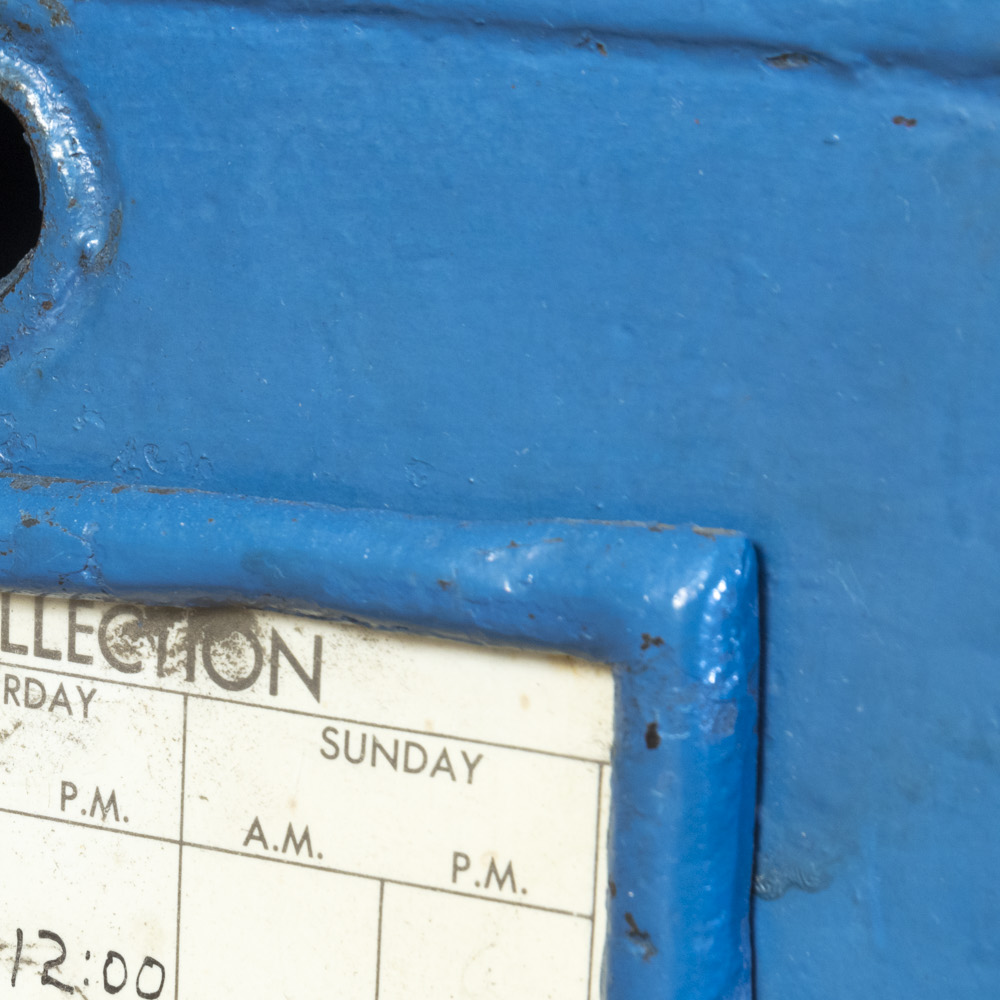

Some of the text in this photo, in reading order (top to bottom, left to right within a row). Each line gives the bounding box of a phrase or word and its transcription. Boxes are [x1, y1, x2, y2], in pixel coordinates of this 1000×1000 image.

[320, 726, 484, 785] SUNDAY
[60, 781, 131, 823] P.M.
[243, 818, 325, 860] A.M.
[452, 851, 529, 895] P.M.
[10, 927, 166, 1000] 12:00
